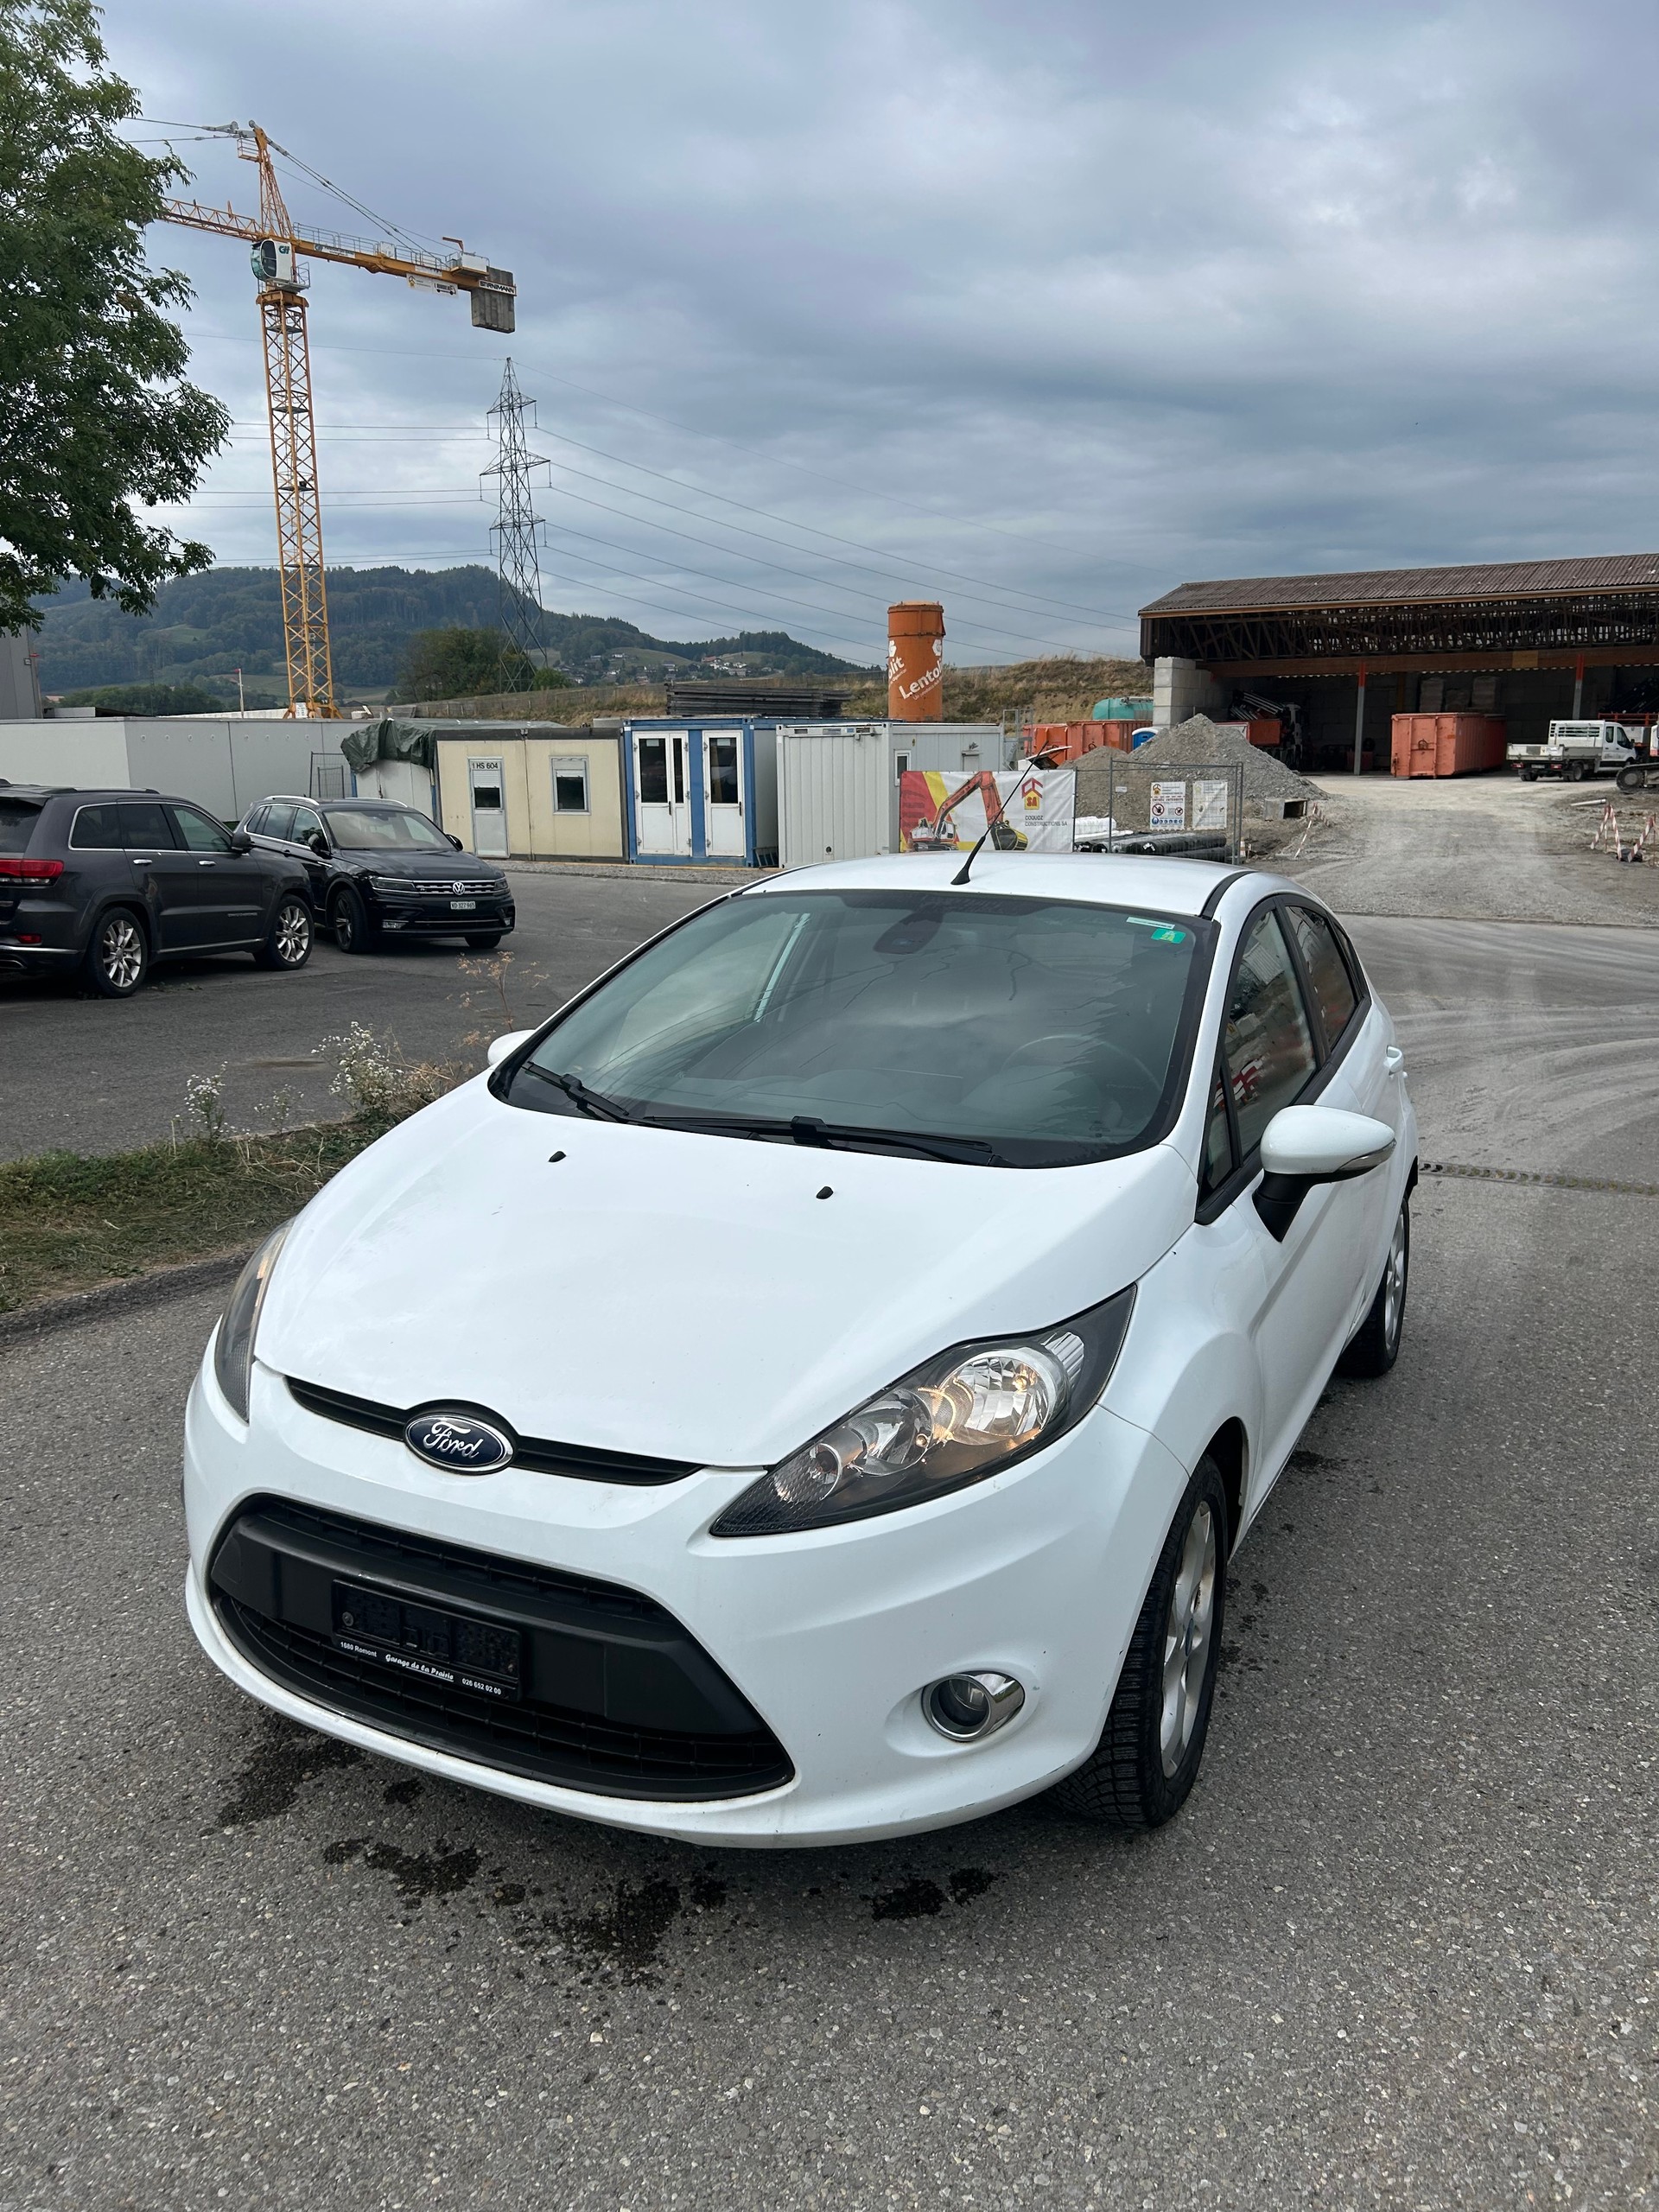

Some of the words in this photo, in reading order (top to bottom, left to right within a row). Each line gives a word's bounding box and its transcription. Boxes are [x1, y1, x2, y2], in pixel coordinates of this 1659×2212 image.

[423, 1421, 484, 1459] Ford
[354, 1645, 378, 1657] Romont
[385, 1654, 410, 1667] Garage
[430, 1668, 454, 1680] Prairie
[474, 1681, 485, 1690] 652
[493, 1687, 502, 1695] 00
